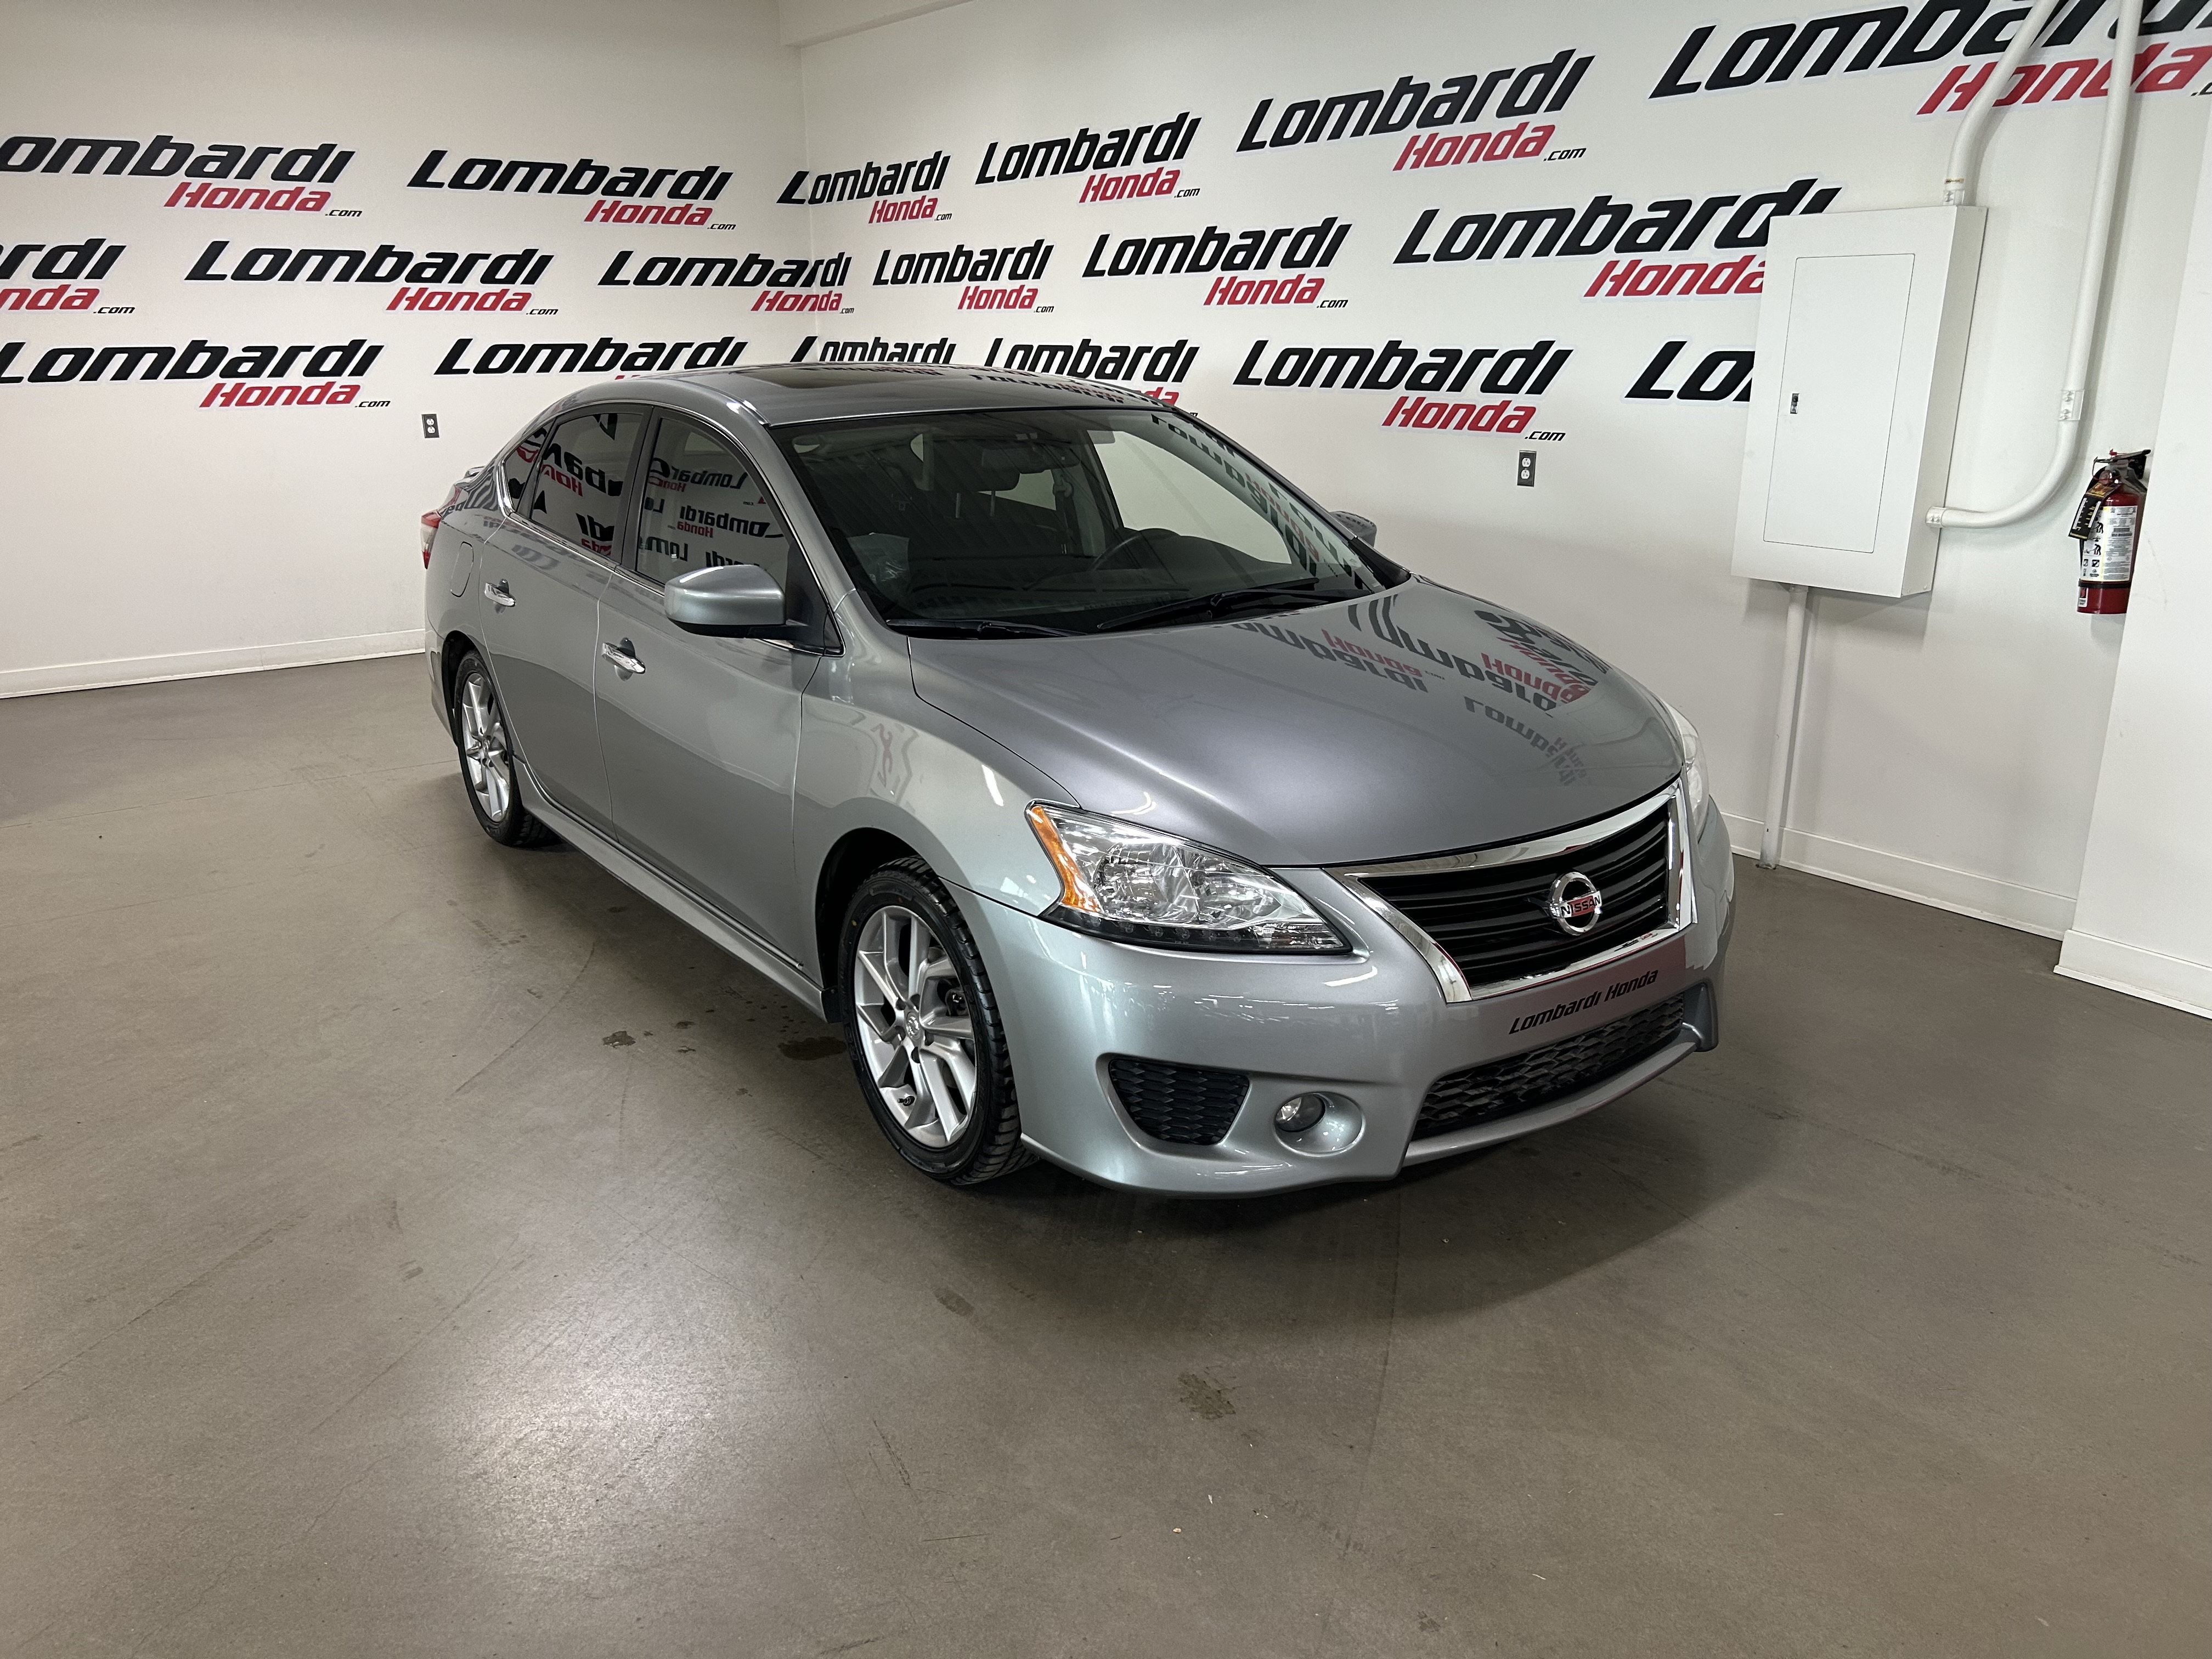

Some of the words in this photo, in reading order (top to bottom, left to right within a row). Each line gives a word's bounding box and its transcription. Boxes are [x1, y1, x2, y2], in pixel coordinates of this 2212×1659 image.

[1237, 49, 1595, 152] Lombardi
[975, 112, 1201, 184] Lombardi
[1395, 123, 1555, 170] Honda
[407, 150, 733, 200] Lombardi
[776, 151, 950, 205] Lombardi
[1080, 167, 1180, 202] Honda
[165, 182, 330, 211] Honda
[585, 200, 711, 225] Honda
[868, 195, 938, 223] Honda
[184, 241, 554, 284] Lombardi
[873, 239, 1054, 285] Lombardi
[1082, 217, 1352, 277] Lombardi
[597, 251, 852, 287] Lombardi
[387, 287, 531, 311] Honda
[752, 291, 842, 311] Honda
[958, 285, 1037, 309] Honda
[1205, 274, 1324, 305] Honda
[0, 340, 384, 383] Lombardi
[434, 337, 748, 375] Lombardi
[984, 338, 1200, 382] Lombardi
[1233, 340, 1573, 394] Lombardi
[200, 381, 360, 407] Honda
[1384, 397, 1536, 433] Honda
[1560, 895, 1601, 916] NISSAN
[1509, 991, 1601, 1034] Lombardi
[1604, 970, 1658, 1002] Honda
